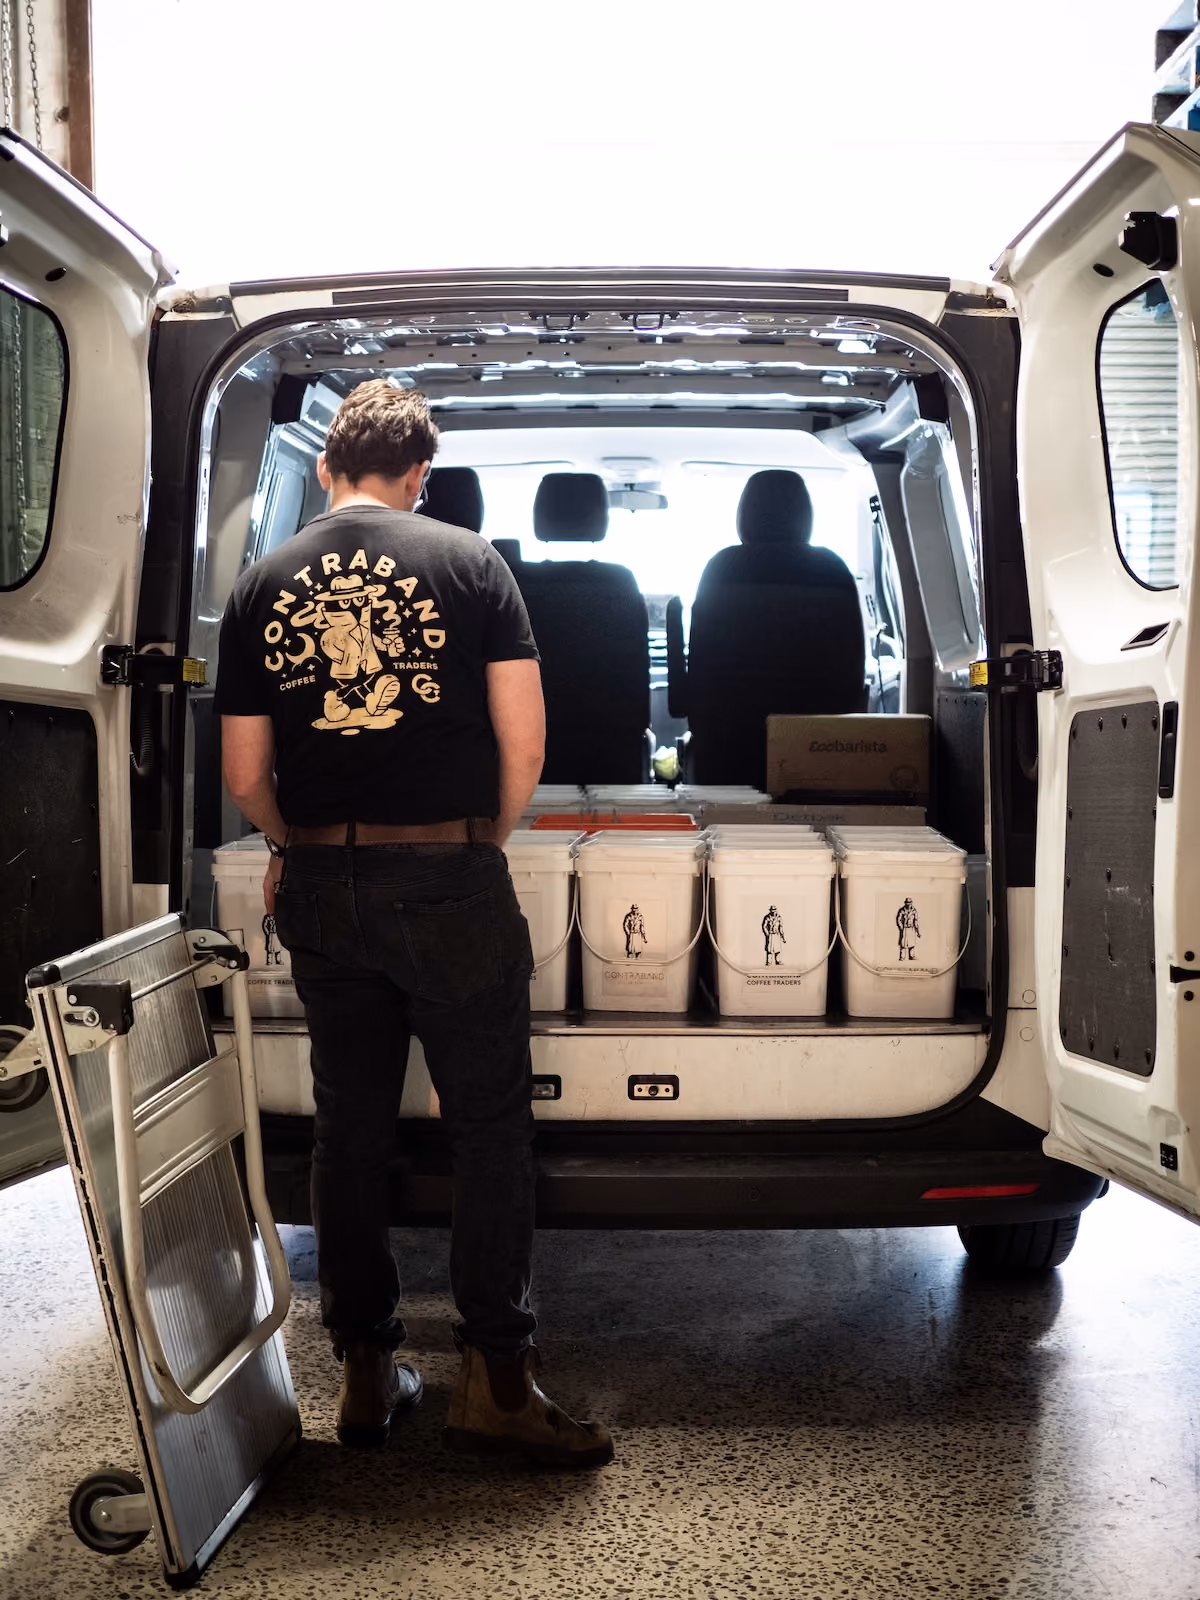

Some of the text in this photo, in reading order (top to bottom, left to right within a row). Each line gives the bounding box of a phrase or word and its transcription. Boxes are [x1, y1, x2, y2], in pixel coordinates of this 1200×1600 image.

[264, 549, 446, 671] CONTRABAND
[393, 661, 438, 670] TRADERS
[279, 675, 316, 691] COFFEE
[809, 740, 887, 753] Ecobarista
[604, 970, 665, 981] CONTRABAND
